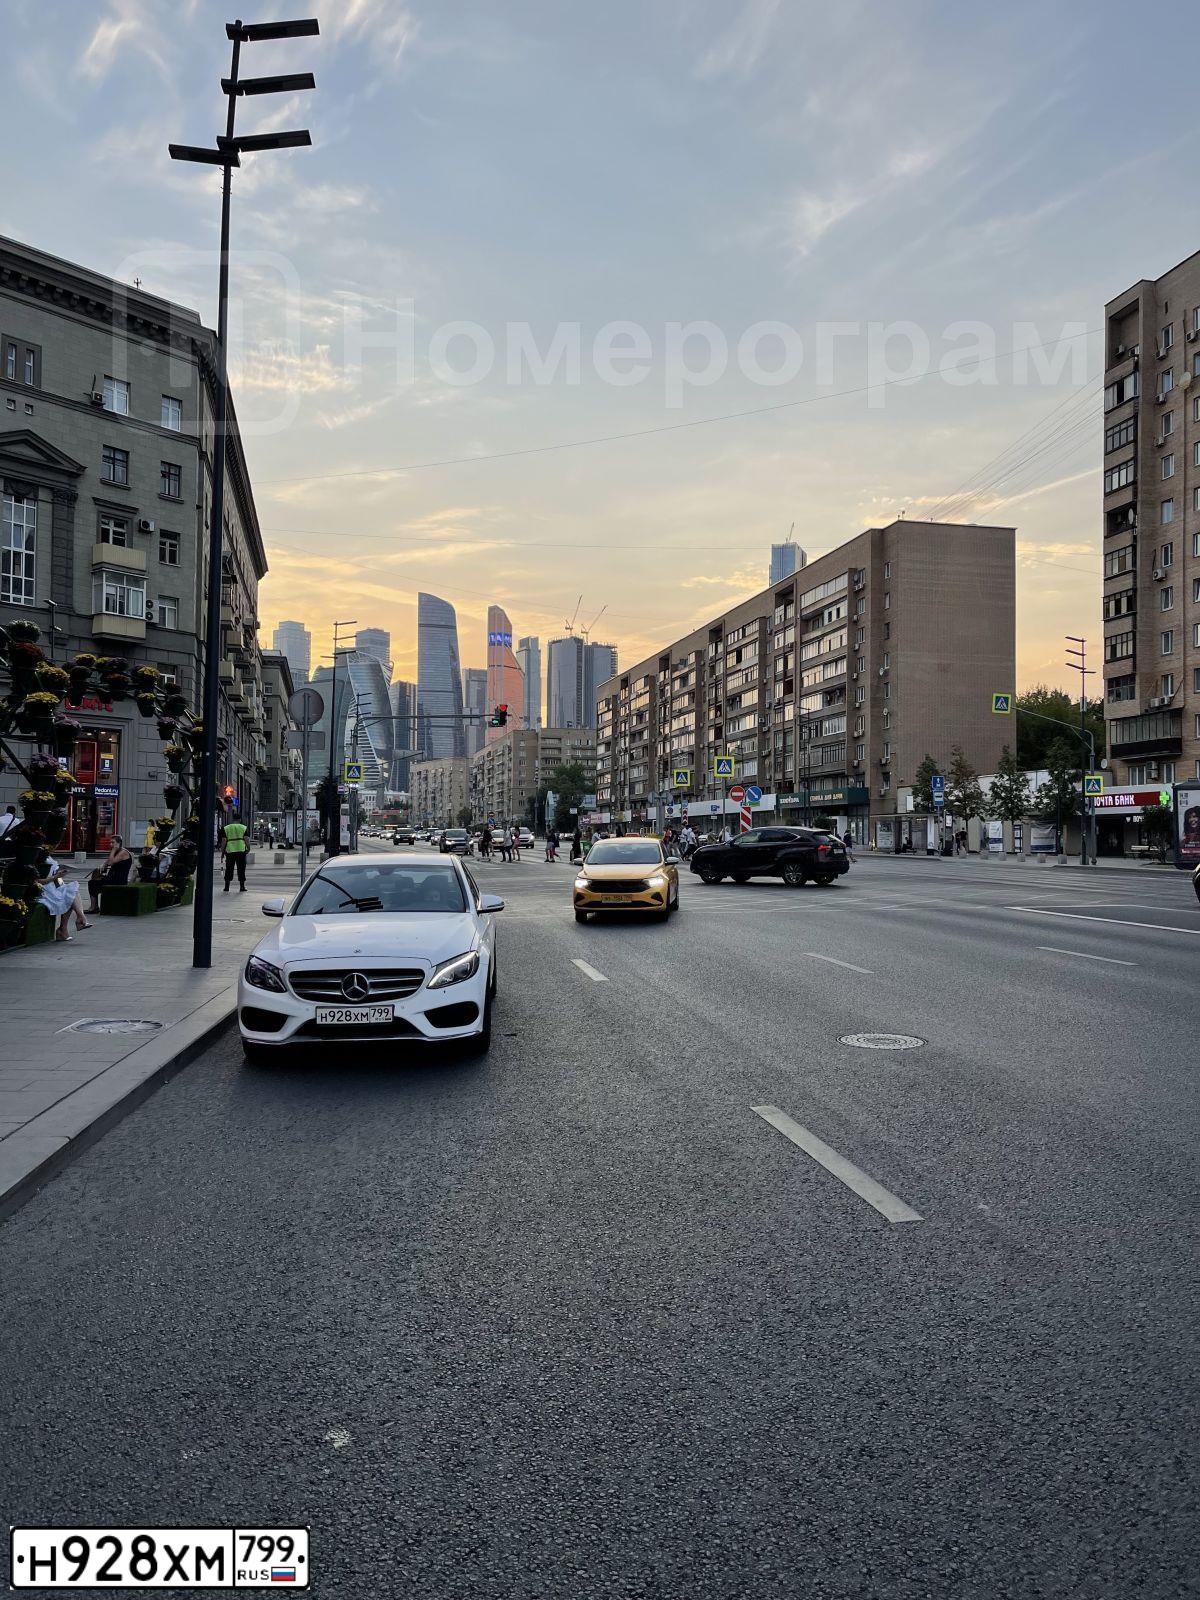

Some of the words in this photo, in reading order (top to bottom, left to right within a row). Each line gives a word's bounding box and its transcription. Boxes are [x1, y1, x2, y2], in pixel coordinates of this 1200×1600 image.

[1115, 795, 1135, 805] БАНК
[320, 1010, 369, 1022] Н928ХМ
[371, 1008, 390, 1017] 799
